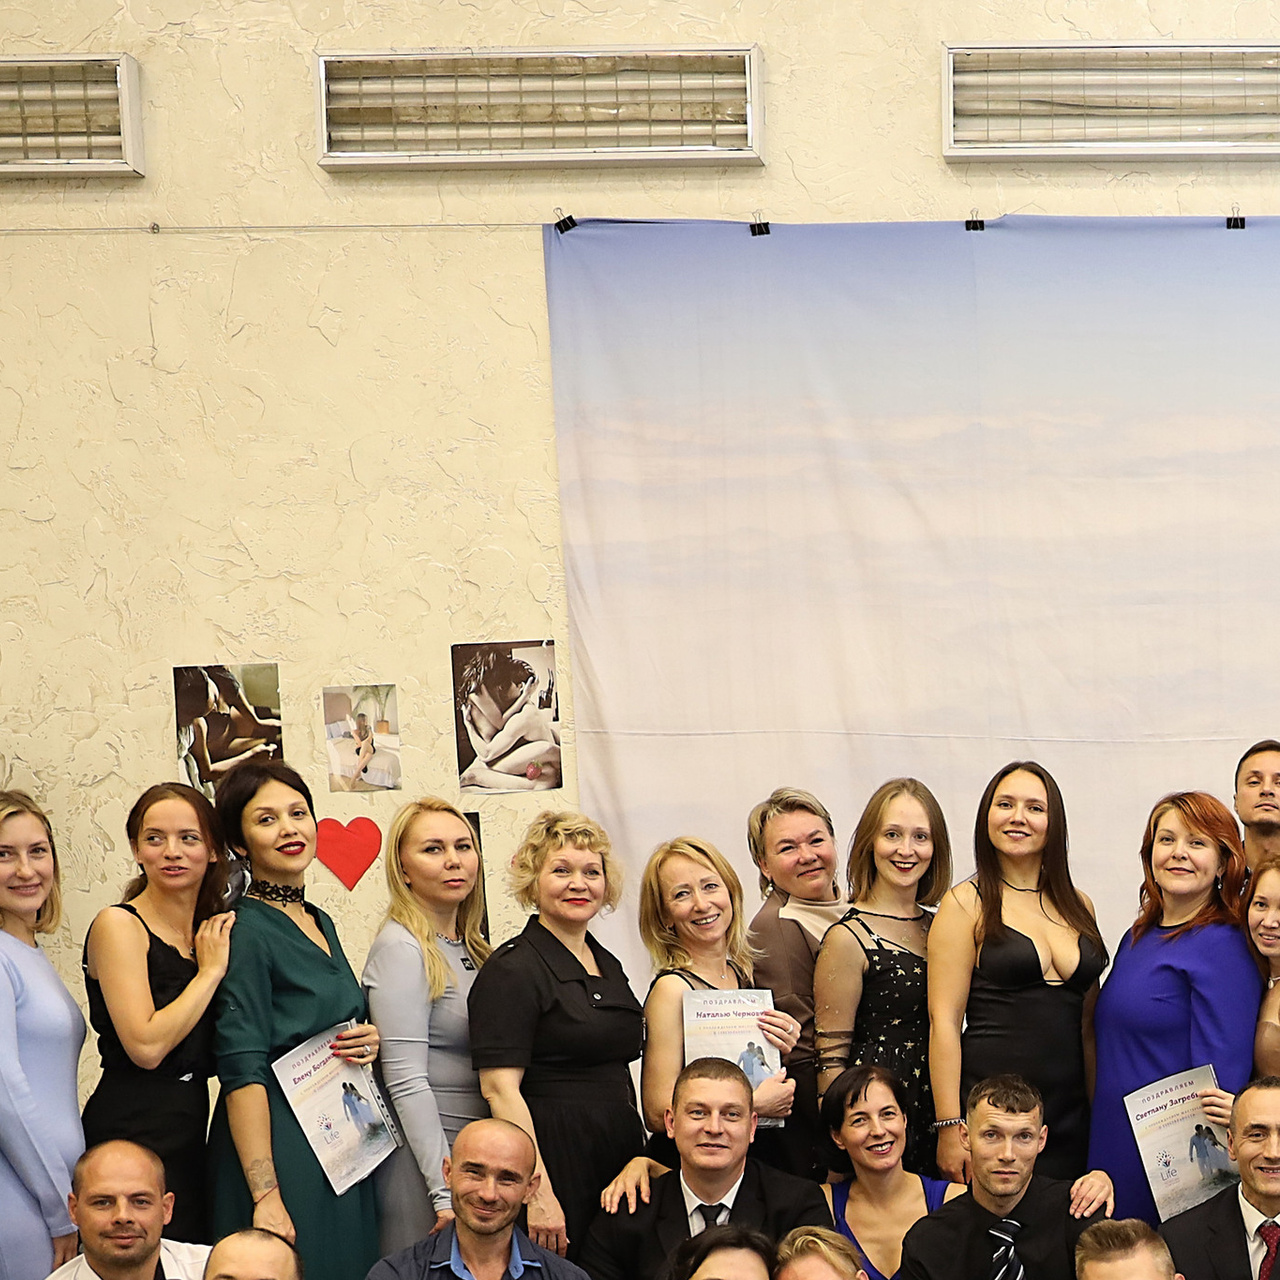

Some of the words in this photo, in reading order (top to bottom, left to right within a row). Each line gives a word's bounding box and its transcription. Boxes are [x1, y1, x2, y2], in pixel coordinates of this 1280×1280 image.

[292, 1069, 312, 1085] Елену
[1142, 1080, 1194, 1104] ПОЗДРАВЛЯЕМ
[1136, 1103, 1168, 1121] Светлану
[324, 1130, 340, 1144] Life
[1160, 1168, 1178, 1181] Life
